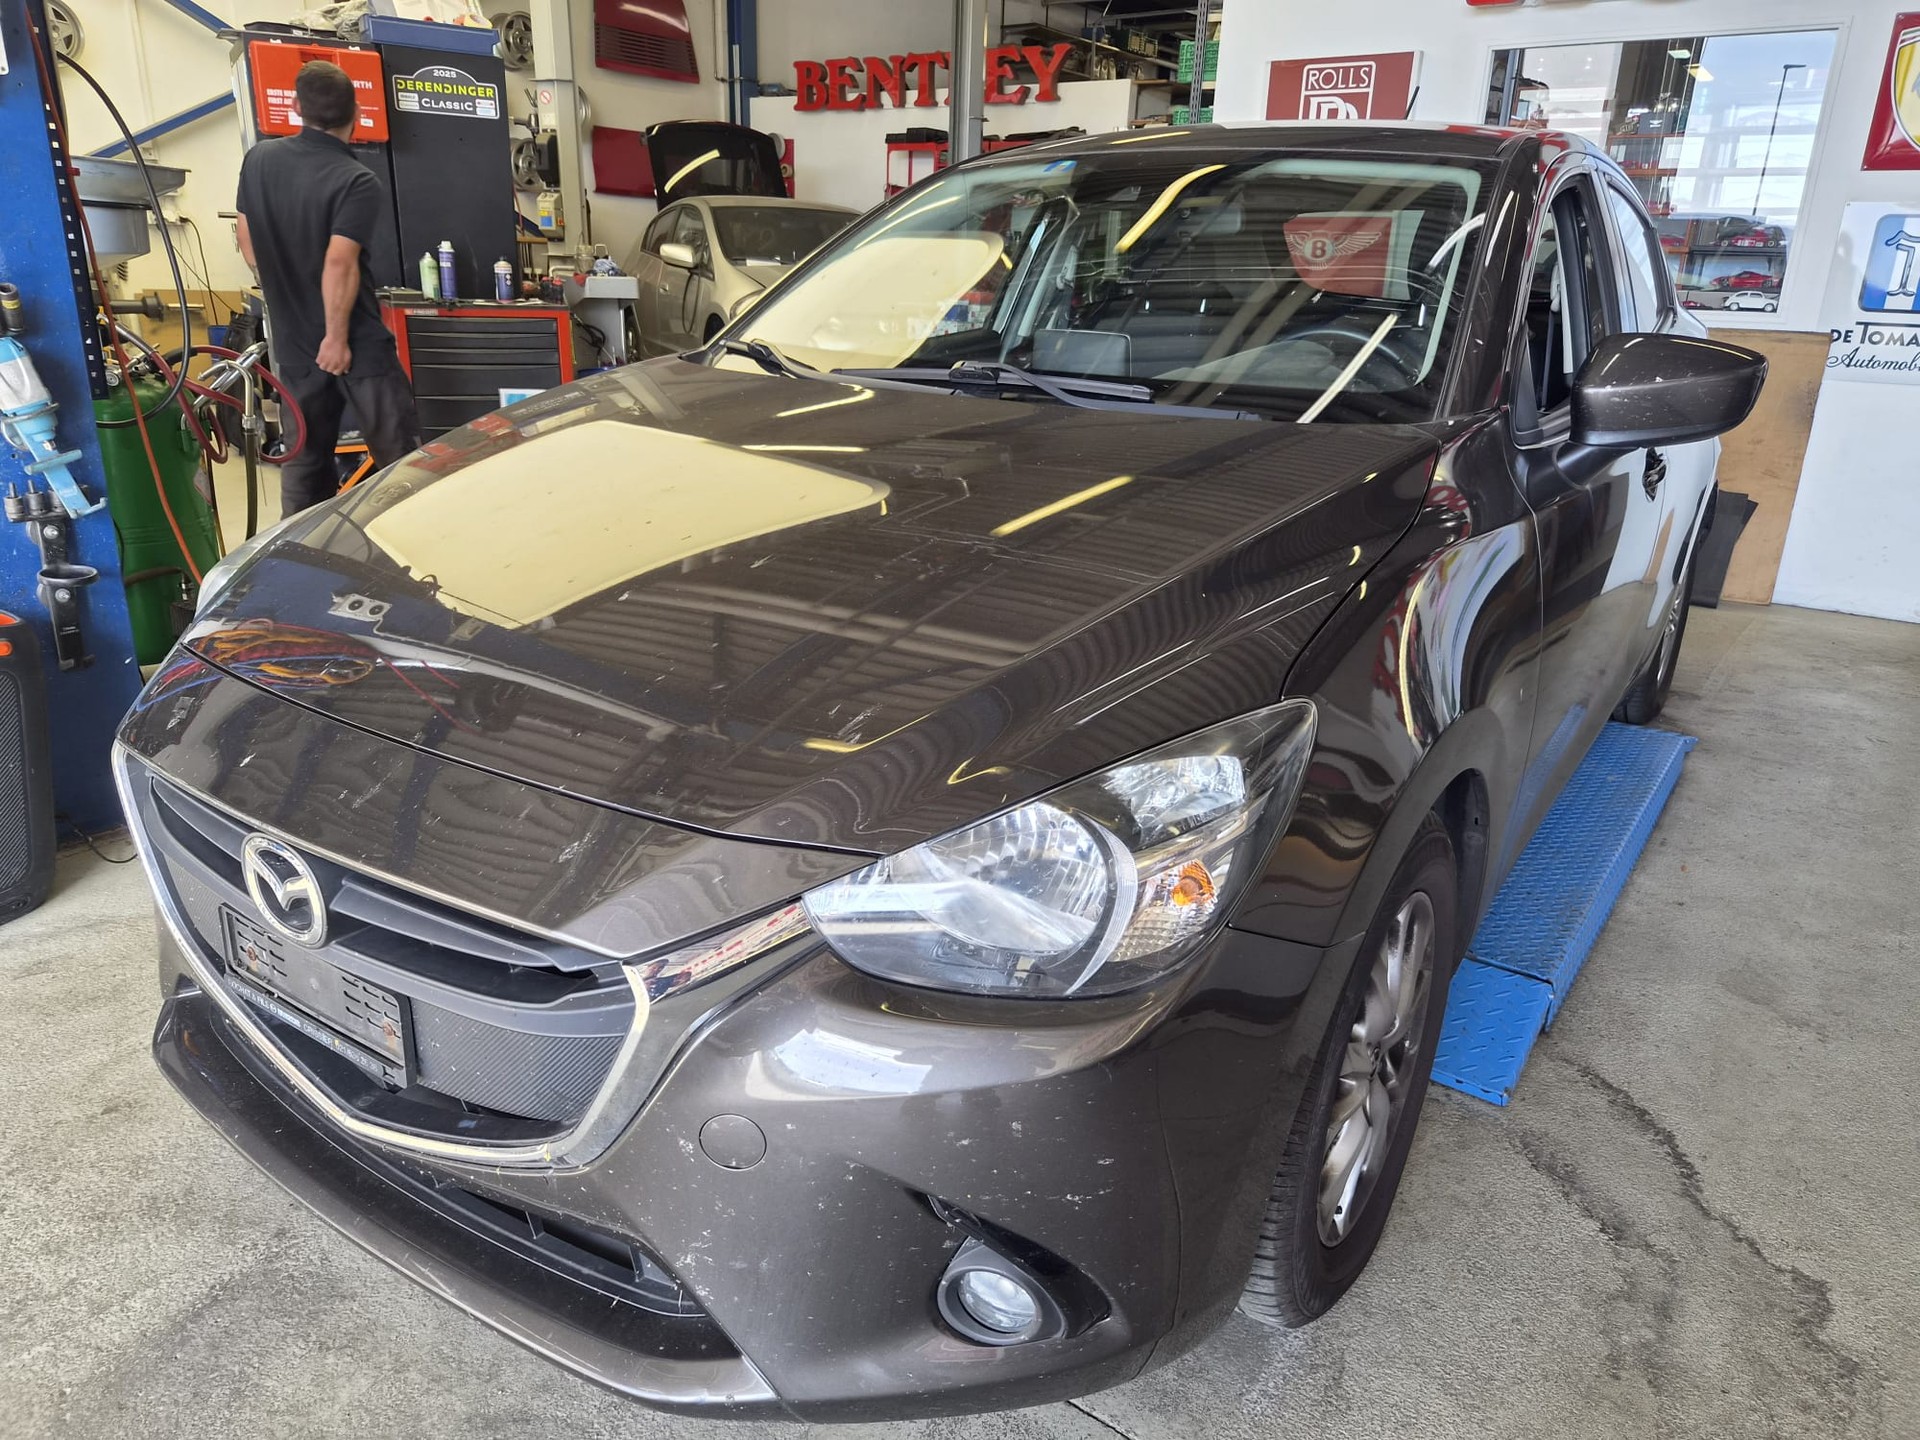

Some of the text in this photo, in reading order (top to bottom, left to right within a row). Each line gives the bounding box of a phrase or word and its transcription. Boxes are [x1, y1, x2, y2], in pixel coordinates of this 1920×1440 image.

[433, 69, 457, 78] 2025
[1308, 67, 1370, 90] ROLLS
[352, 80, 372, 89] RTH
[397, 80, 494, 98] DERENDINGER
[421, 98, 473, 111] CLASSIC
[1311, 240, 1327, 258] B
[1830, 329, 1853, 343] DE
